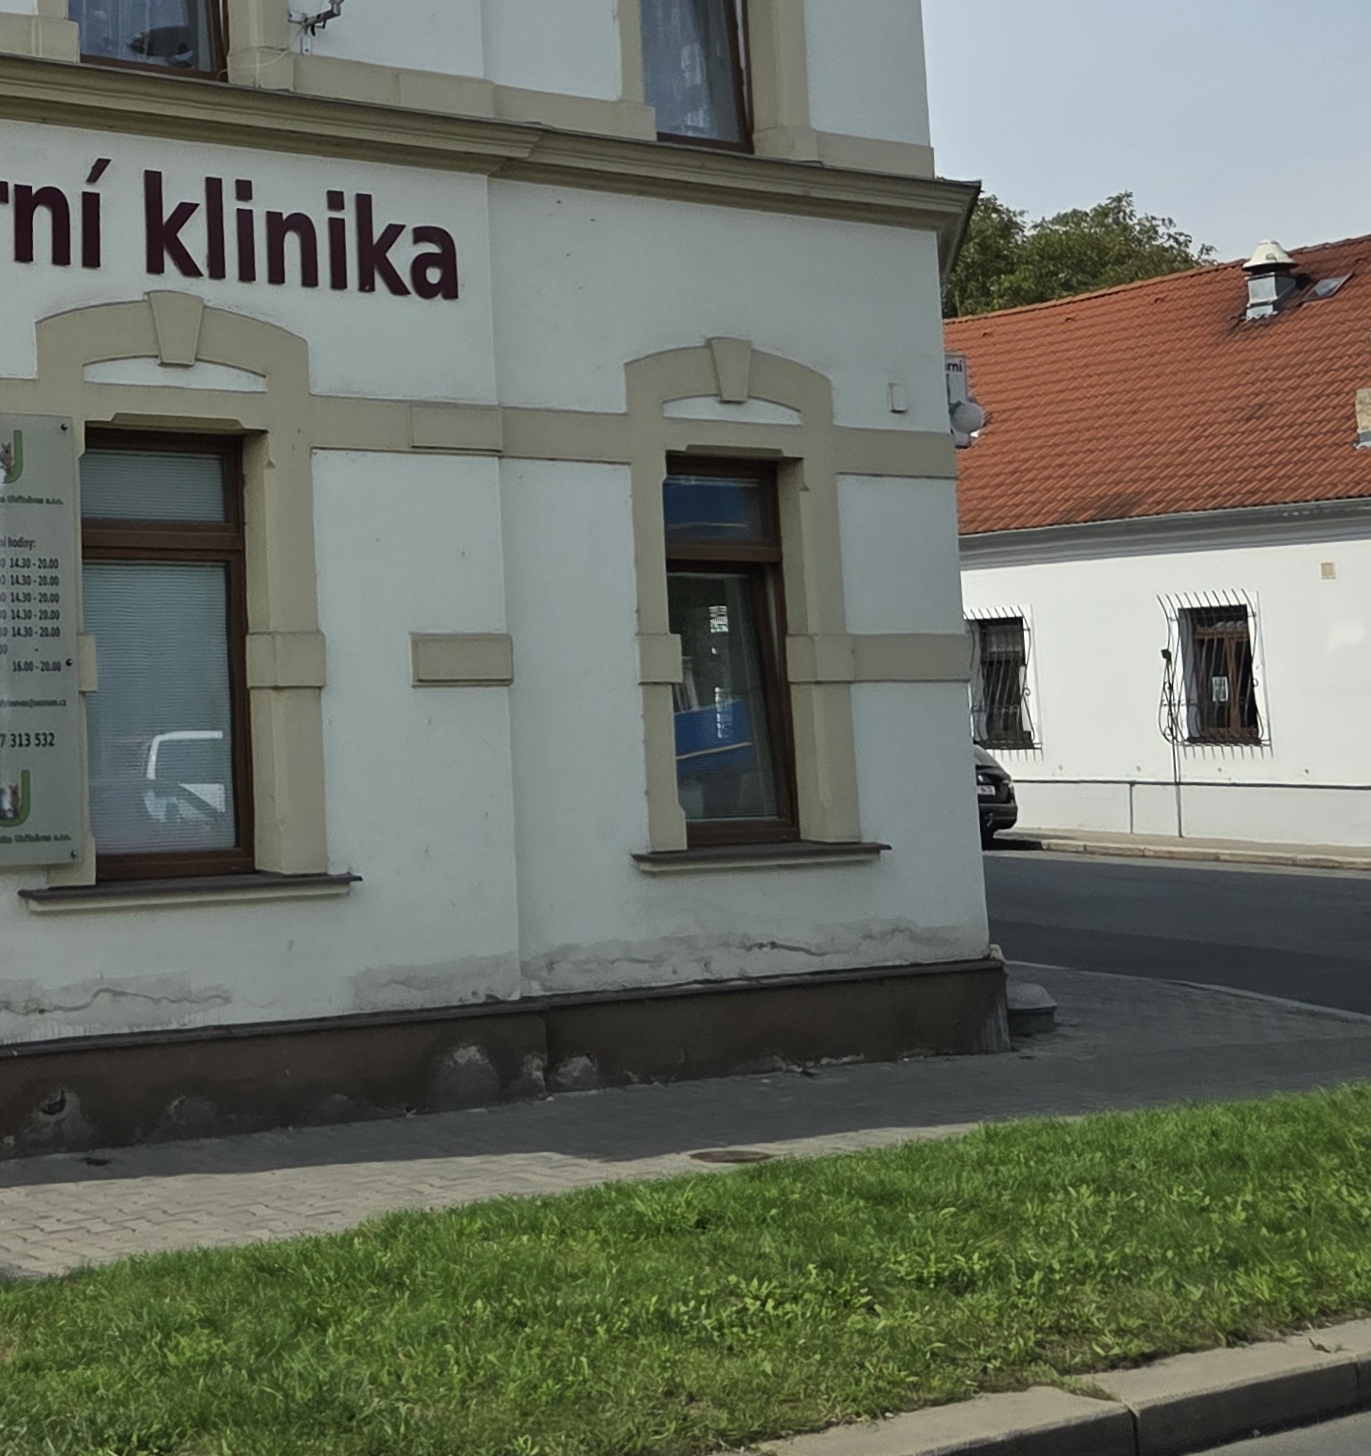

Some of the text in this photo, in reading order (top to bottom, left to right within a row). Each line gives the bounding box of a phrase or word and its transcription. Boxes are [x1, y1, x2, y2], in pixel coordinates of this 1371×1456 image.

[143, 169, 459, 301] klinika
[10, 732, 31, 748] 313
[34, 731, 55, 747] 532
